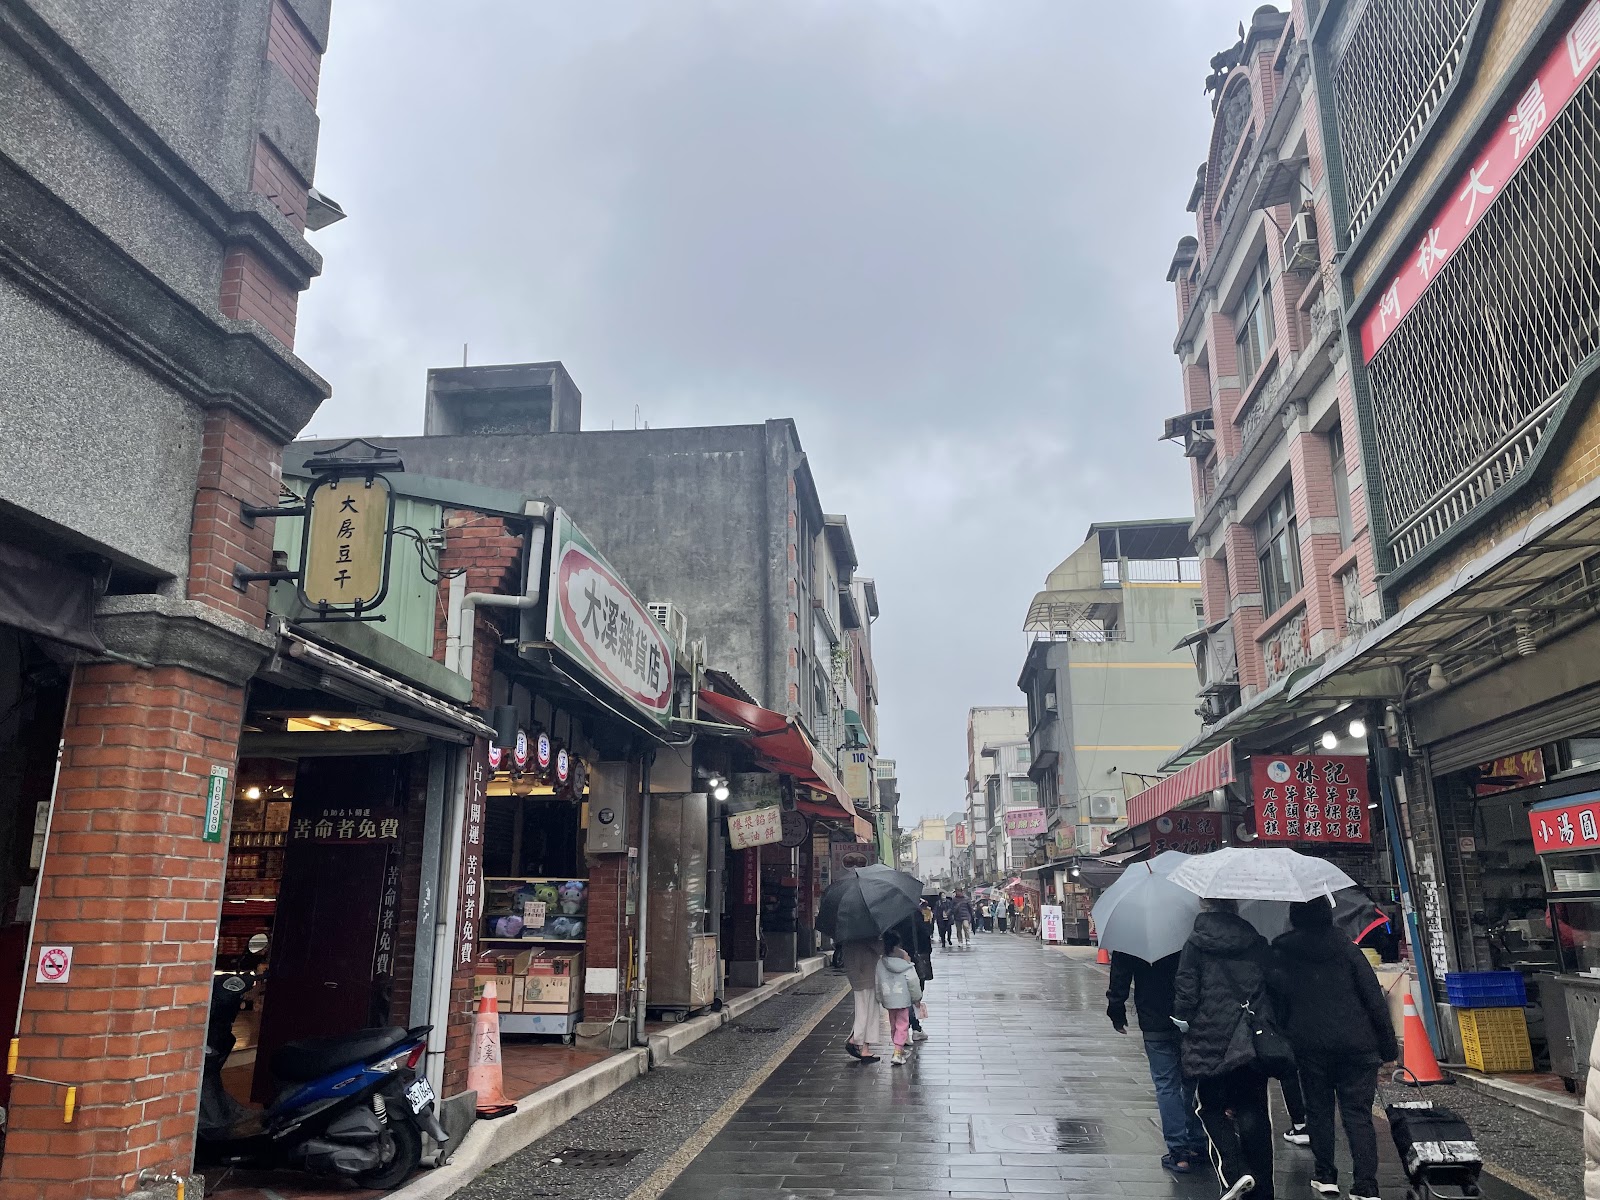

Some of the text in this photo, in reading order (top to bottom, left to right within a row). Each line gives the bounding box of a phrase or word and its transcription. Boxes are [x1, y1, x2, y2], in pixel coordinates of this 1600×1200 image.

[1378, 0, 1600, 333] 阿秋大湯圓
[334, 494, 359, 590] 大房豆干
[582, 578, 661, 693] 大溪雜貨店
[852, 753, 866, 764] 110
[1295, 759, 1350, 785] 林記
[210, 778, 222, 832] 1062089
[293, 818, 400, 839] 苦命者免費
[1176, 815, 1215, 835] 林記
[1304, 785, 1322, 836] 草仔粿
[1324, 786, 1341, 837] 芋粿巧
[1346, 787, 1362, 838] 黑糖糕
[1537, 809, 1598, 845] 小湯圓
[460, 761, 484, 965] 占卜開運 苦命者免費
[375, 866, 399, 975] 苦命者免費
